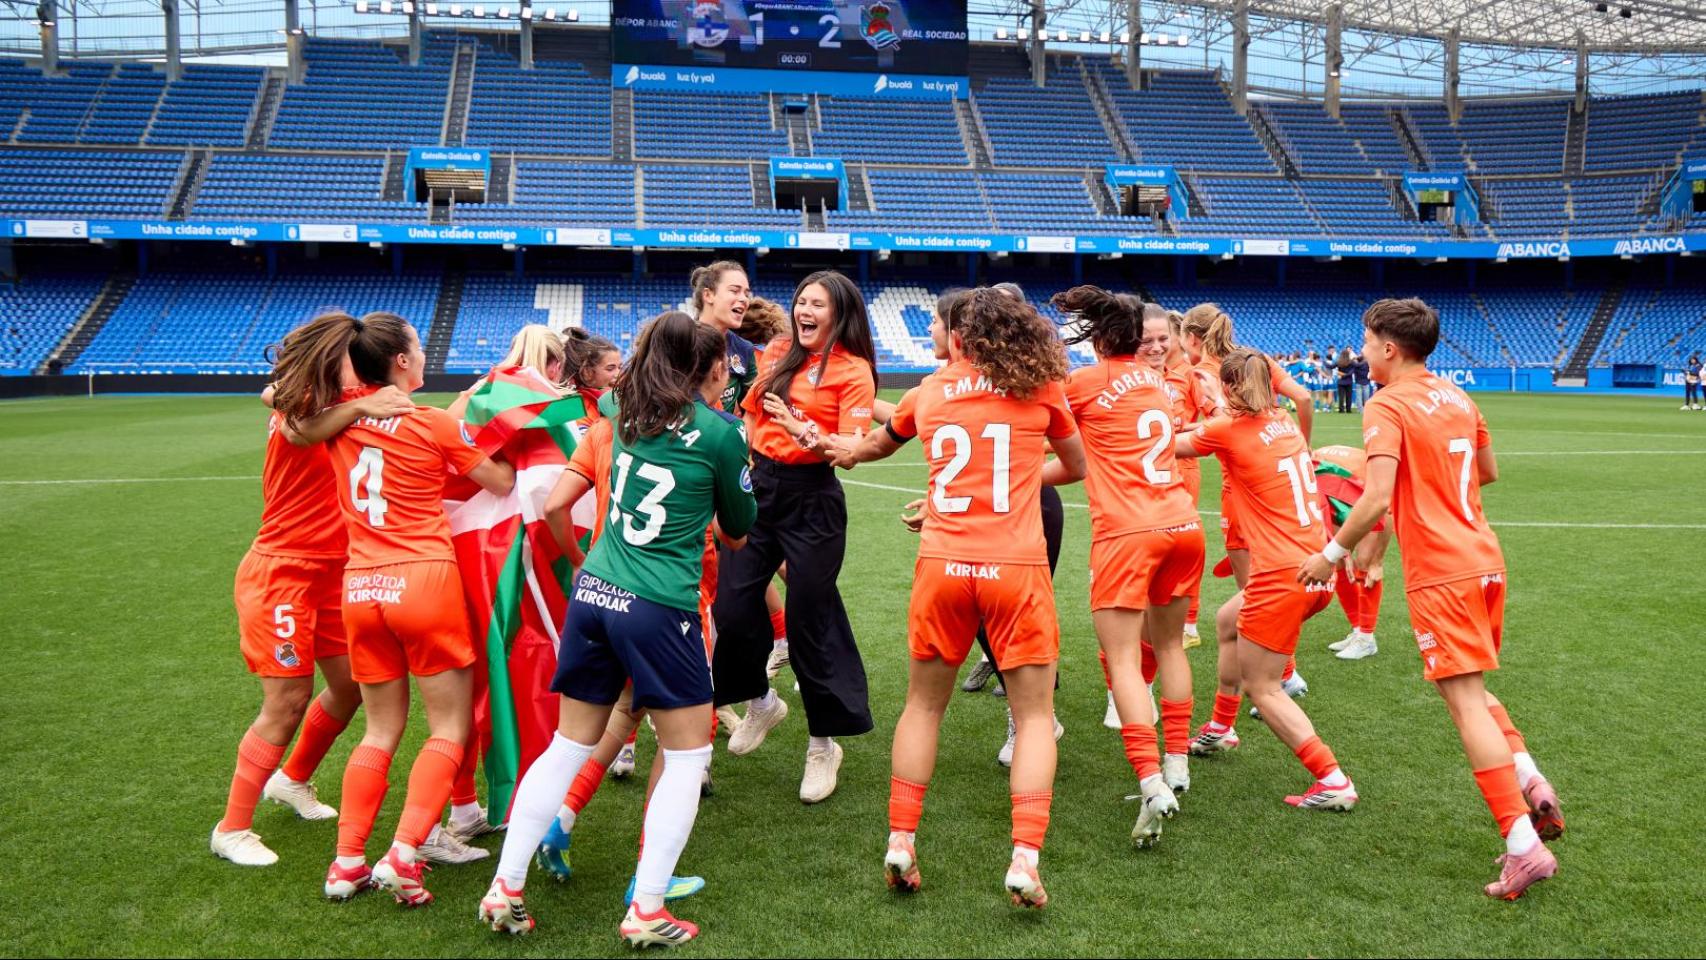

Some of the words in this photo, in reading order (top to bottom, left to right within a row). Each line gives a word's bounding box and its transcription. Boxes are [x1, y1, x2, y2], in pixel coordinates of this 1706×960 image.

[647, 19, 678, 28] ABANC
[748, 12, 764, 45] 1
[818, 14, 841, 48] 2
[902, 29, 923, 38] REAL
[925, 30, 967, 40] SOCIEDAD
[781, 54, 807, 63] 00:00
[142, 223, 172, 234] Unha
[175, 224, 213, 235] cidade
[215, 225, 257, 238] contigo
[408, 227, 437, 238] Unha
[439, 228, 475, 239] cidade
[477, 229, 517, 241] contigo
[658, 231, 686, 242] Unha
[688, 232, 721, 243] cidade
[724, 233, 761, 245] contigo
[895, 236, 920, 246] Unha
[923, 236, 954, 247] cidade
[956, 238, 991, 249] contigo
[1118, 239, 1142, 249] Unha
[1144, 240, 1174, 250] cidade
[1176, 241, 1209, 252] contigo
[1330, 242, 1352, 252] Unha
[1355, 243, 1382, 253] cidade
[1384, 244, 1416, 255] contigo
[1503, 243, 1571, 257] ABANCA
[1619, 237, 1686, 254] ABANCA
[1136, 409, 1172, 484] 2
[931, 424, 1011, 512] 21
[350, 446, 388, 527] 4
[1449, 438, 1473, 521] 7
[1278, 452, 1323, 527] 19
[610, 452, 676, 546] 13
[575, 588, 632, 612] KIROLAK
[274, 604, 295, 638] 5
